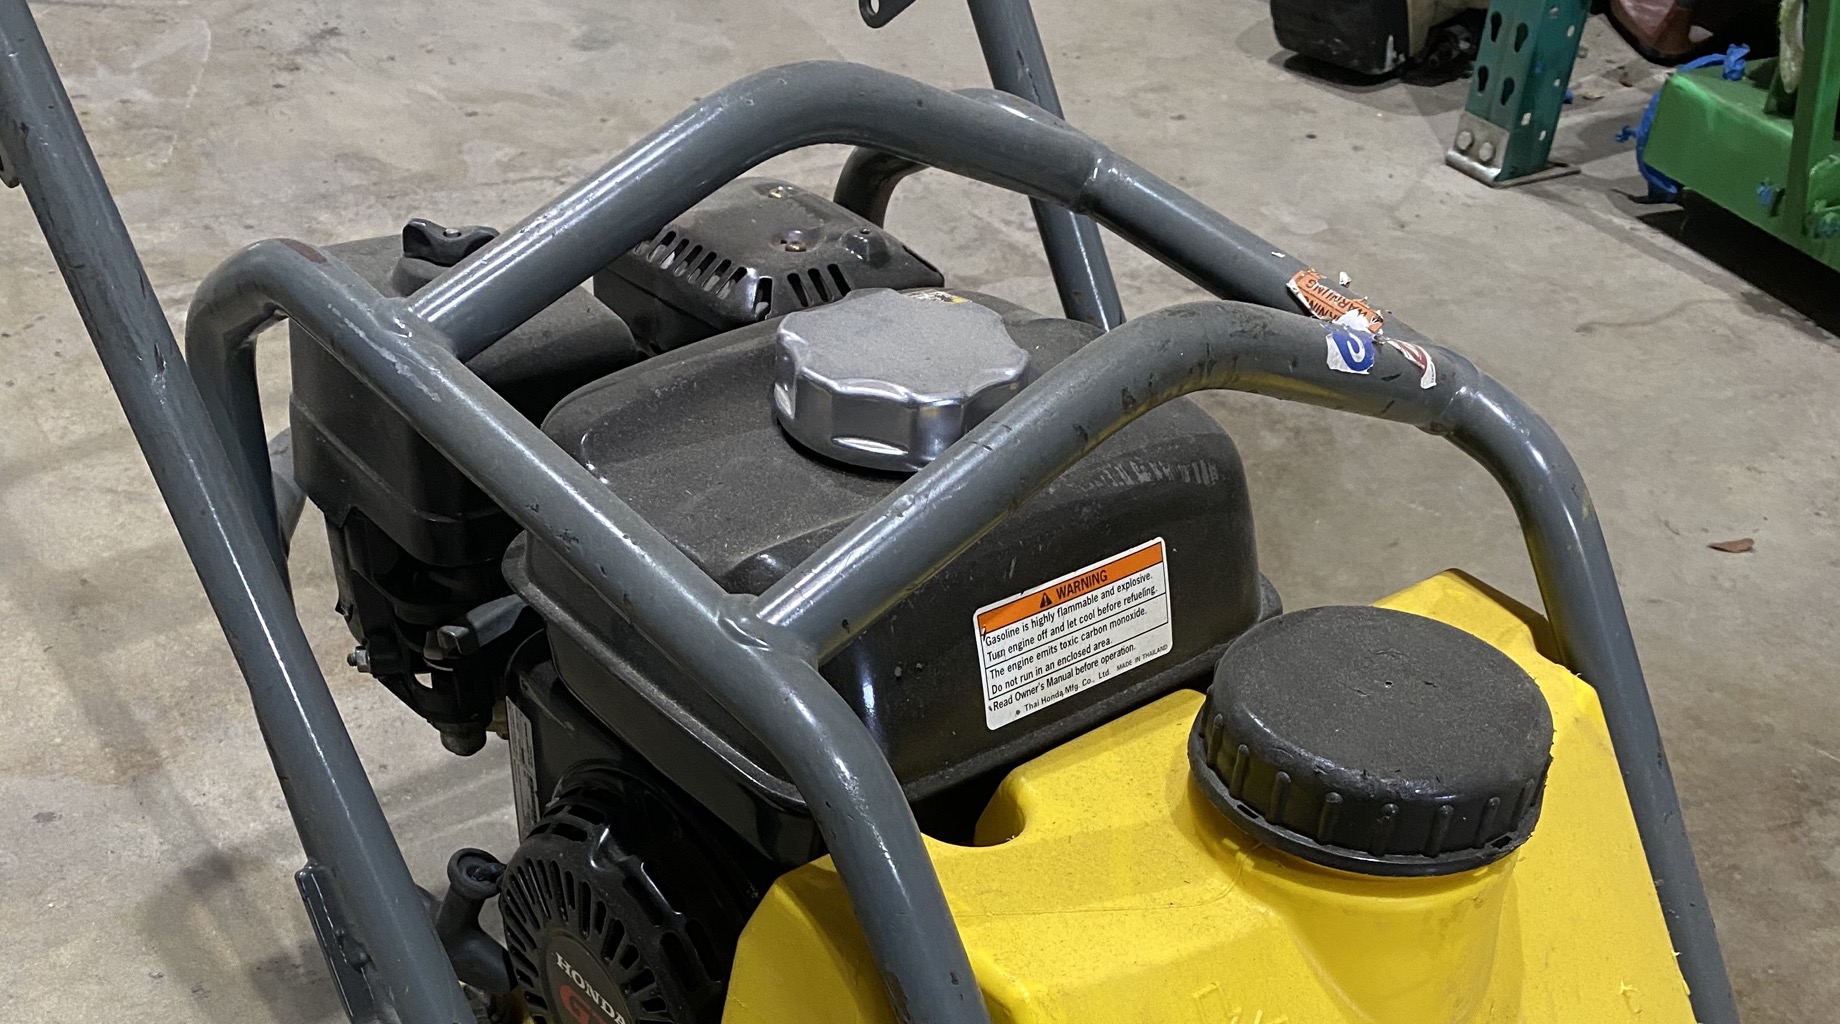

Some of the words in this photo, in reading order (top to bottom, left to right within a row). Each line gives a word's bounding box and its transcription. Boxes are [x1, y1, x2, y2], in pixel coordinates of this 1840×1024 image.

[986, 626, 1020, 647] Gasoline
[1022, 621, 1029, 632] is
[1031, 611, 1055, 628] highly
[1057, 594, 1099, 618] flammable
[1100, 586, 1115, 600] and
[1116, 572, 1153, 593] explosive.
[1056, 569, 1109, 600] WARNING
[987, 648, 1006, 662] Turn
[1007, 636, 1035, 654] engine
[1037, 628, 1048, 642] off
[1050, 622, 1065, 636] and
[1067, 617, 1077, 629] let
[1079, 610, 1096, 624] cool
[1097, 599, 1122, 616] before
[1123, 585, 1158, 606] refueling.
[990, 667, 1005, 680] The
[1007, 654, 1034, 672] engine
[1036, 644, 1058, 660] emits
[1060, 635, 1079, 650] toxic
[1080, 622, 1108, 641] carbon
[1109, 607, 1148, 630] monoxide.
[991, 684, 1002, 695] Do
[1005, 677, 1018, 691] not
[1020, 670, 1034, 684] run
[1035, 666, 1043, 678] in
[1045, 661, 1055, 672] an
[1057, 645, 1091, 665] enclosed
[1093, 638, 1112, 651] area.
[993, 695, 1013, 712] Read
[1014, 683, 1045, 701] Owner's
[1046, 669, 1074, 688] Manual
[1075, 659, 1099, 676] before
[1100, 643, 1136, 665] operation.
[1024, 699, 1040, 712] Thai
[1098, 668, 1111, 679] Ltd.
[1116, 660, 1133, 672] MADE
[1134, 655, 1141, 664] IN
[1142, 644, 1168, 658] THAILAND
